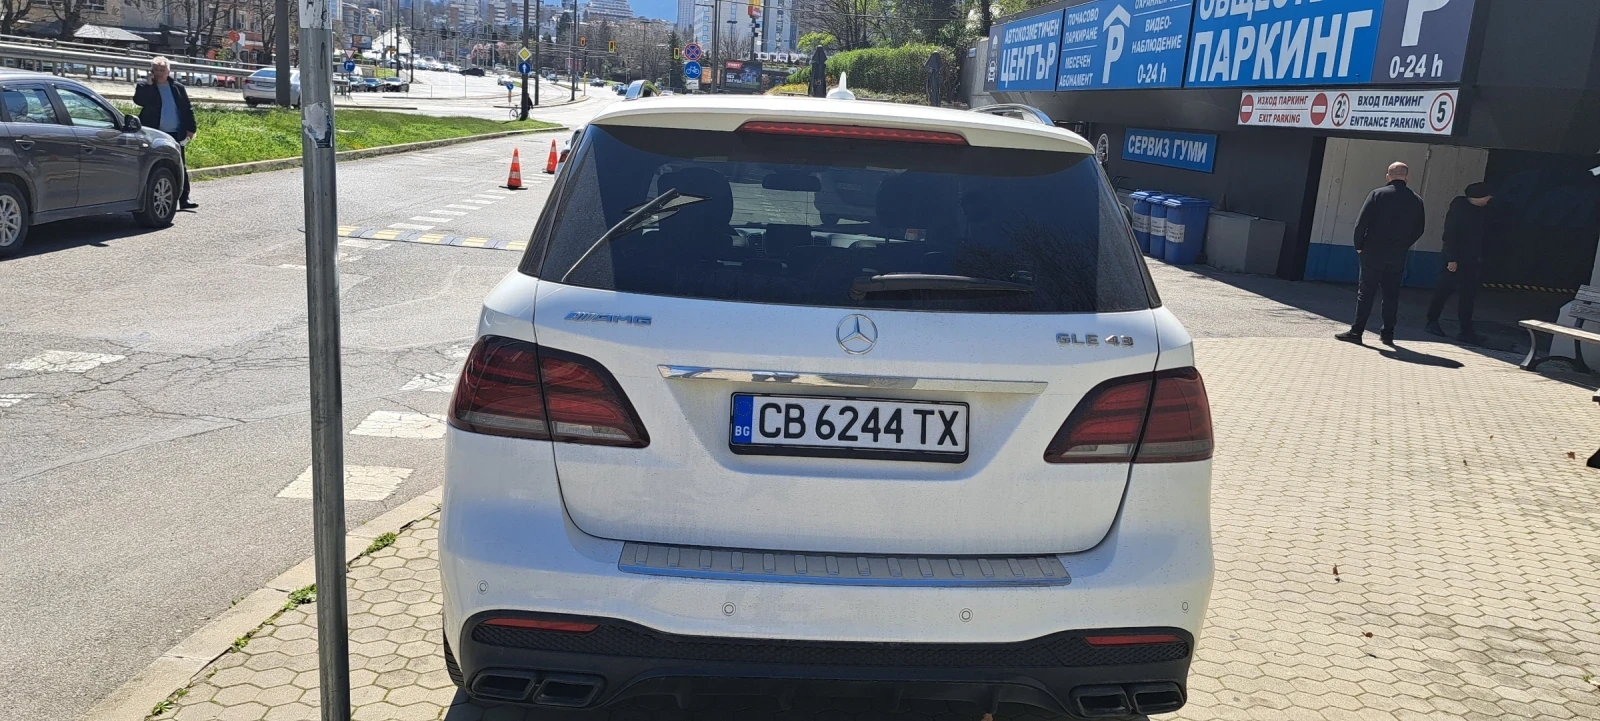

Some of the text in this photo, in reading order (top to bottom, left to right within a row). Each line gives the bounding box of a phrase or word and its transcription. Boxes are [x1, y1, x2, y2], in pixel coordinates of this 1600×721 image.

[1068, 8, 1099, 26] ПОЧАСОВО
[1004, 18, 1060, 44] АВТОКОЗМЕТИЧЕН
[1065, 27, 1098, 44] ПАРКИРАНЕ
[1131, 35, 1182, 53] НАБЛЮДЕНИЕ
[1188, 9, 1373, 82] ПАРКИНГ
[1065, 54, 1091, 69] МЕСЕЧЕН
[1102, 24, 1125, 84] P
[1000, 42, 1057, 88] ЦЕНТЪР
[1137, 62, 1167, 84] 0-24 h
[1389, 54, 1443, 78] 0-24 h
[1059, 73, 1094, 87] АБОНАМЕНТ
[1257, 96, 1308, 107] ИЗХОД ПАРКИНГ
[1357, 96, 1424, 108] ВХОД ПАРКИНГ
[1258, 114, 1300, 123] EXIT PARKING
[1436, 101, 1447, 123] 5
[1350, 116, 1425, 129] ENTRANCE PARKING
[1128, 135, 1207, 163] СЕРВИЗ ГУМИ
[1056, 333, 1134, 346] GLE 43
[734, 425, 750, 437] BG
[759, 403, 959, 446] CB 6244 TX
